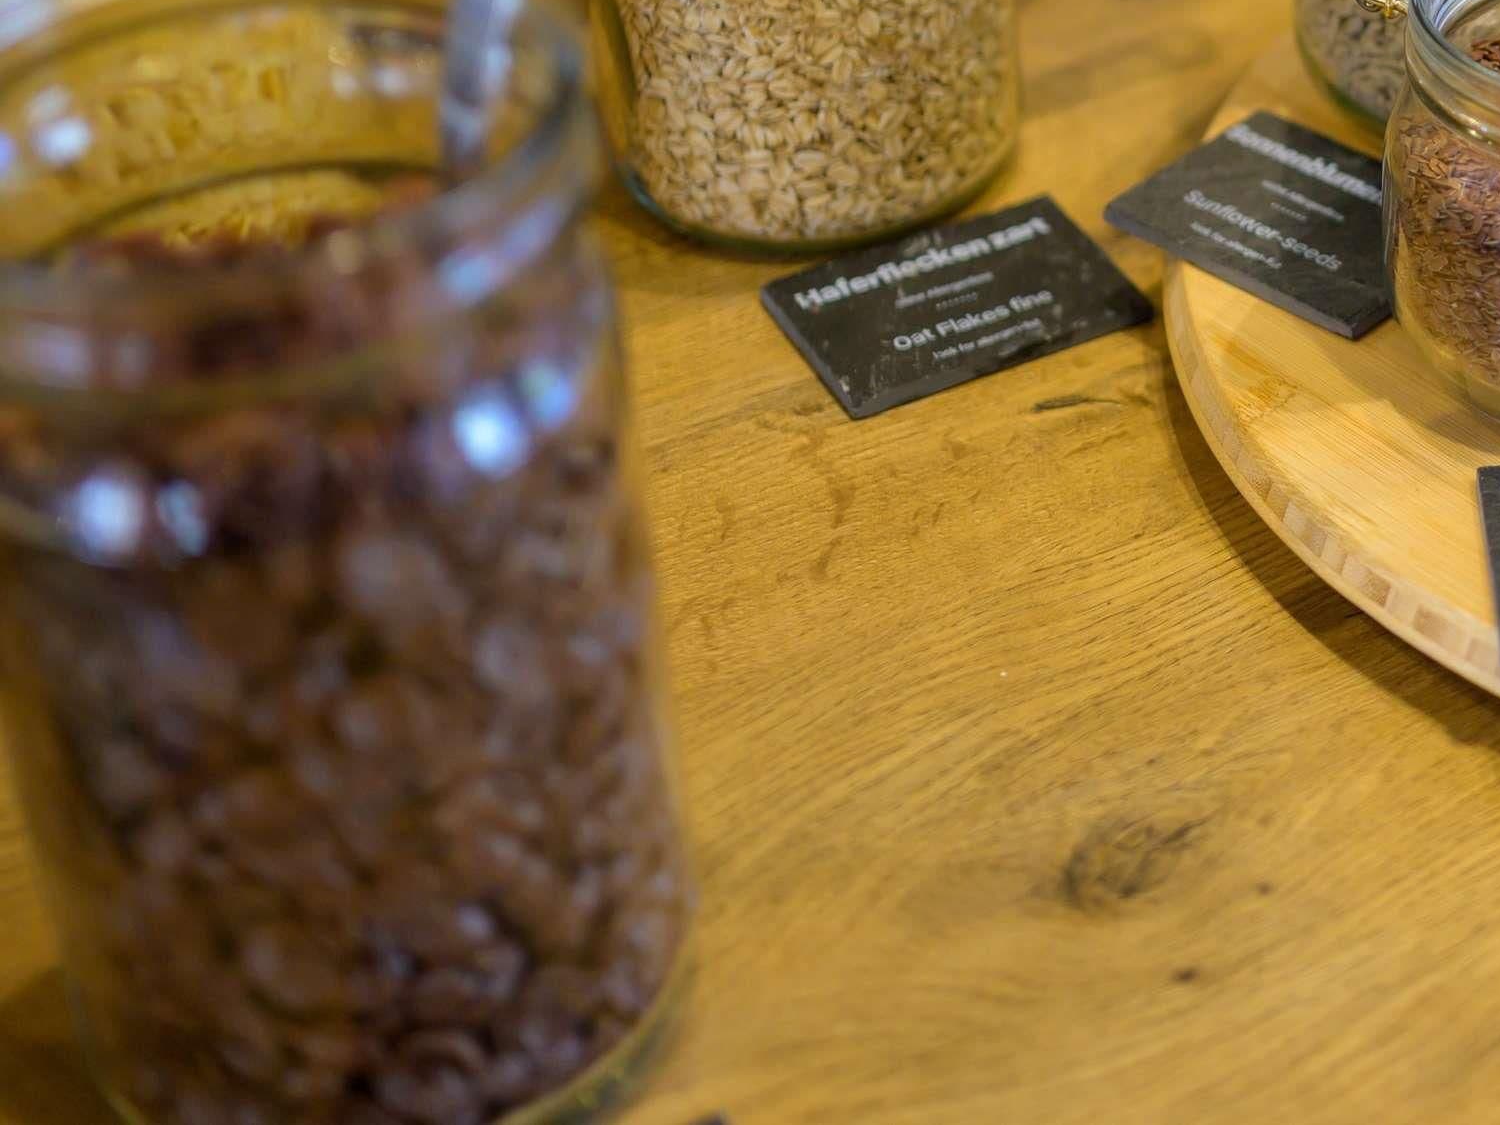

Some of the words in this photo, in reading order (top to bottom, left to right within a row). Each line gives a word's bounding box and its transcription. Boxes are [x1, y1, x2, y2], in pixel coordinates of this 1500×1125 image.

[1224, 124, 1383, 206] Sonnenblume
[793, 237, 992, 309] Haferflocken
[987, 217, 1050, 251] zart
[1184, 189, 1342, 271] Sunflower-seeds
[893, 328, 936, 351] Oat
[936, 305, 1010, 337] Flakes
[1009, 290, 1053, 312] fine
